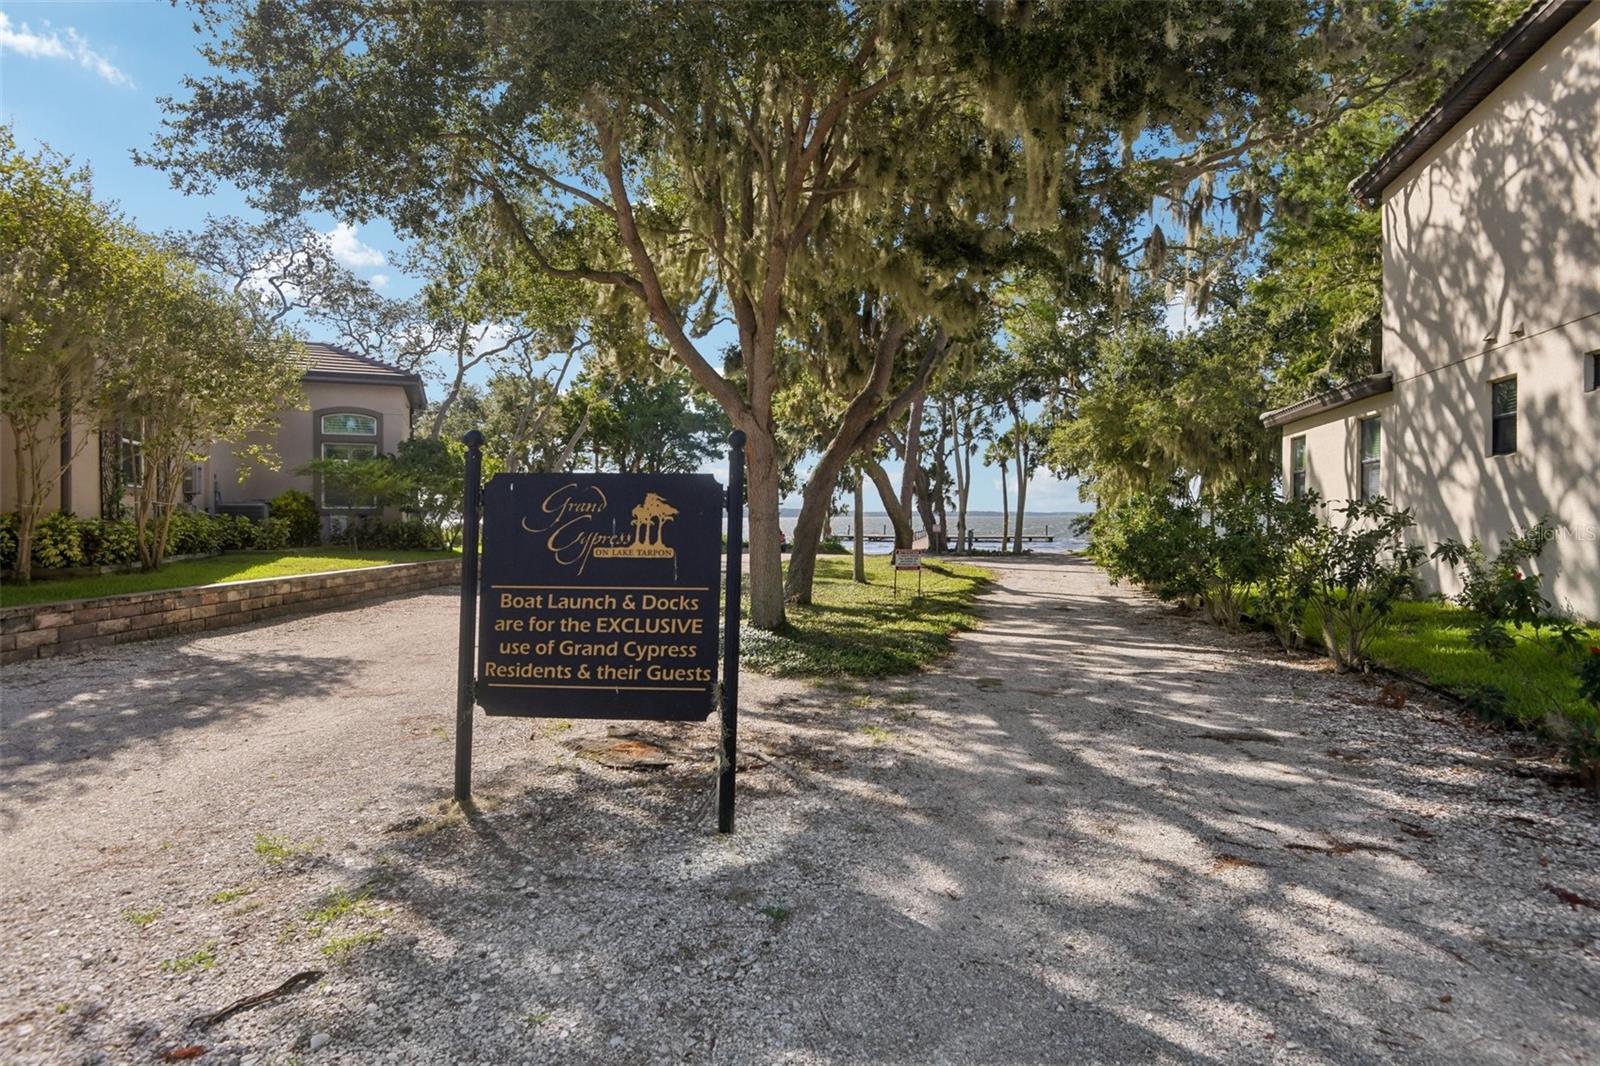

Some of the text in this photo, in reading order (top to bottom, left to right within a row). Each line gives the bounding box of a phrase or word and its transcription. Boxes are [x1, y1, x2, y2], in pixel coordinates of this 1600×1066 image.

[522, 483, 608, 532] Grand
[547, 515, 632, 576] Cypress
[595, 549, 673, 558] ON LAKE TARPON
[500, 593, 699, 611] Boat Launch & Docks
[494, 616, 703, 634] are for the EXCLUSIVE
[499, 640, 697, 661] use of Grand Cypress
[484, 662, 711, 682] Residents & their Guests
